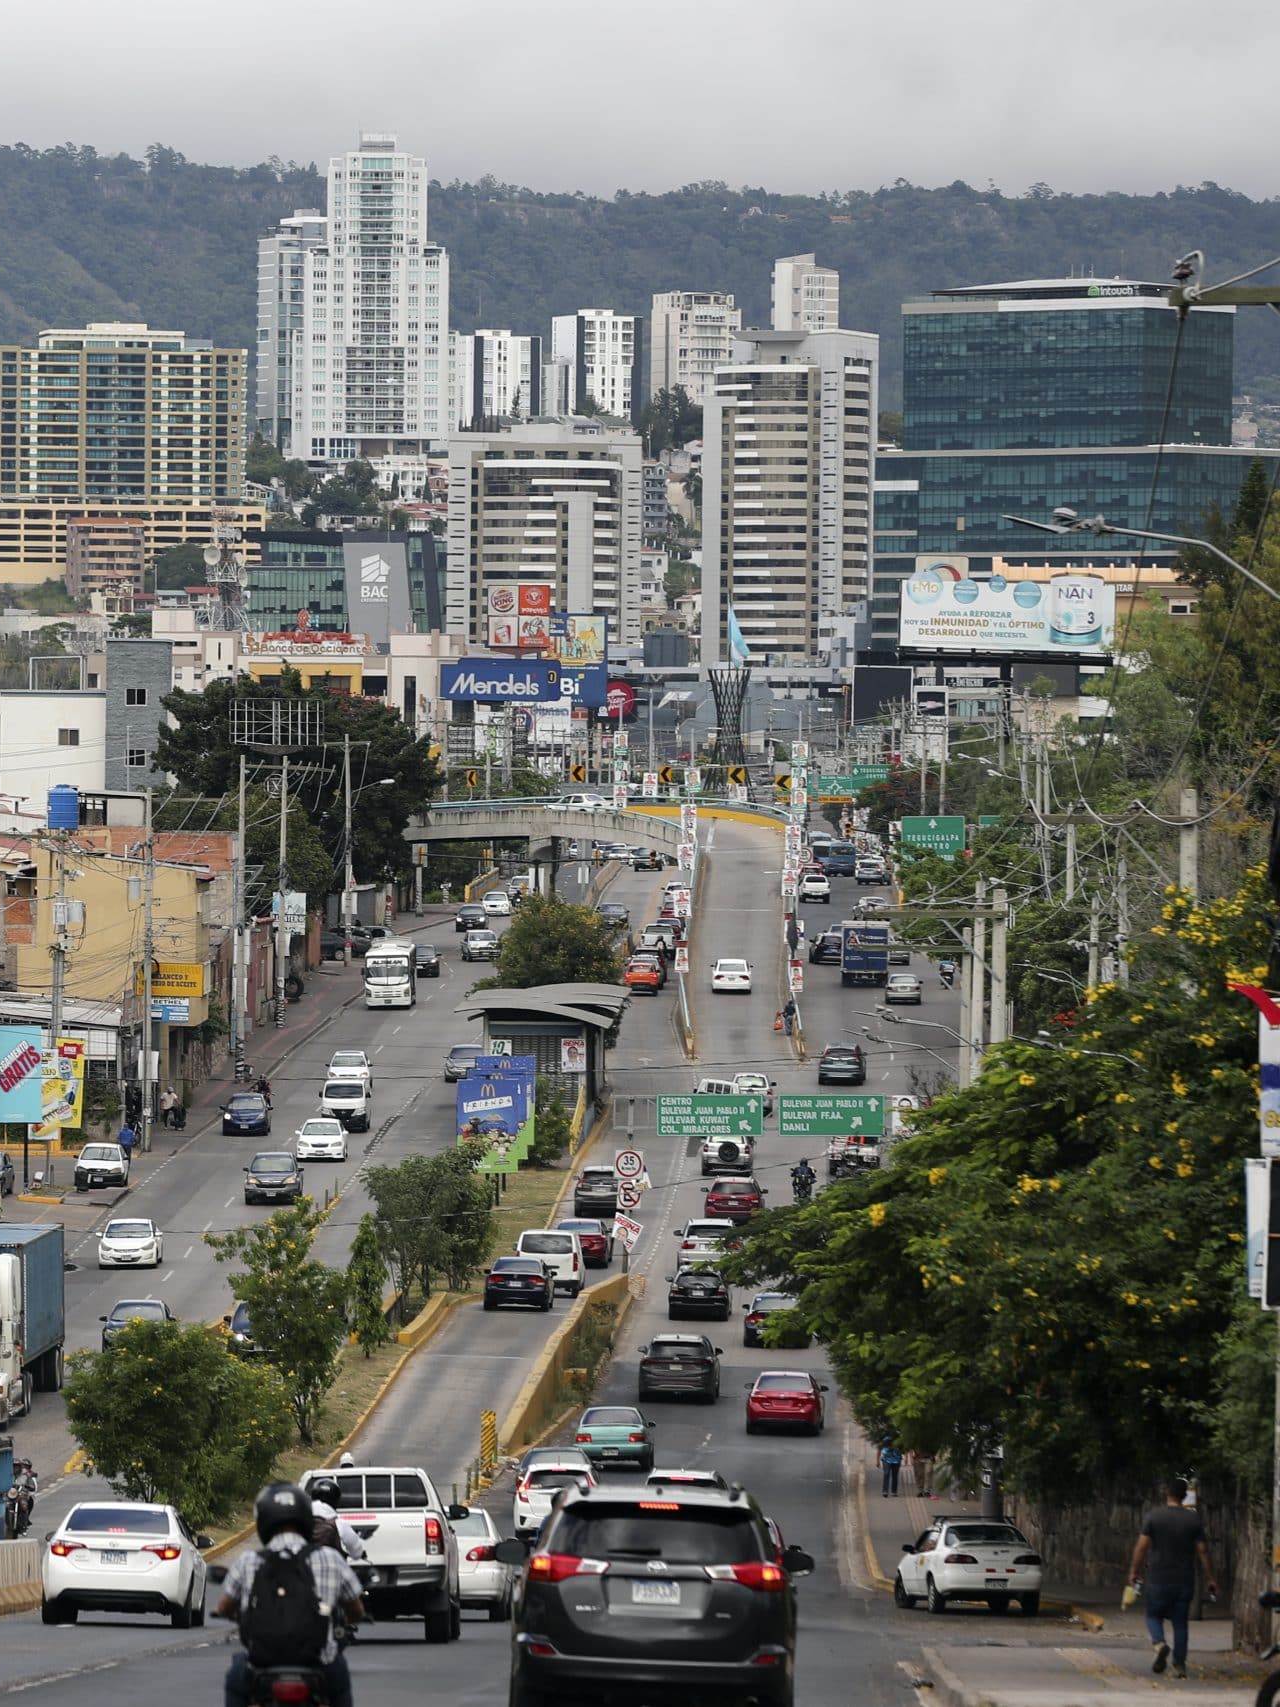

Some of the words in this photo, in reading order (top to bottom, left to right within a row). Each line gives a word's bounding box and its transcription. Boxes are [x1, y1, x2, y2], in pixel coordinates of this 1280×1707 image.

[1100, 286, 1133, 296] Intouch
[361, 585, 389, 598] BAC
[1058, 587, 1093, 600] NAN
[494, 597, 514, 606] KING
[969, 611, 1012, 619] REFORZAR
[1087, 611, 1095, 625] 3
[918, 628, 978, 637] DESARROLLO
[979, 631, 993, 639] QUE
[449, 672, 540, 696] Mendels
[559, 677, 580, 695] Bi
[906, 834, 960, 842] TEGUCIGALPA
[677, 909, 688, 917] 62
[491, 1040, 506, 1055] 10
[660, 1097, 693, 1106] CENTRO
[782, 1099, 812, 1108] BULEVAR
[815, 1099, 834, 1108] JUAN
[835, 1099, 858, 1108] PABLO
[660, 1106, 692, 1115] BULEVAR
[694, 1106, 714, 1115] JUAN
[716, 1106, 738, 1115] PABLO
[782, 1111, 818, 1120] BULEVAR
[660, 1115, 697, 1125] BULEVAR
[699, 1115, 731, 1125] KUWAIT
[660, 1125, 680, 1134] COL.
[682, 1125, 732, 1134] MIRAFLORES
[782, 1123, 810, 1132] DANLI
[623, 1155, 635, 1166] 35
[615, 1216, 641, 1234] REINA
